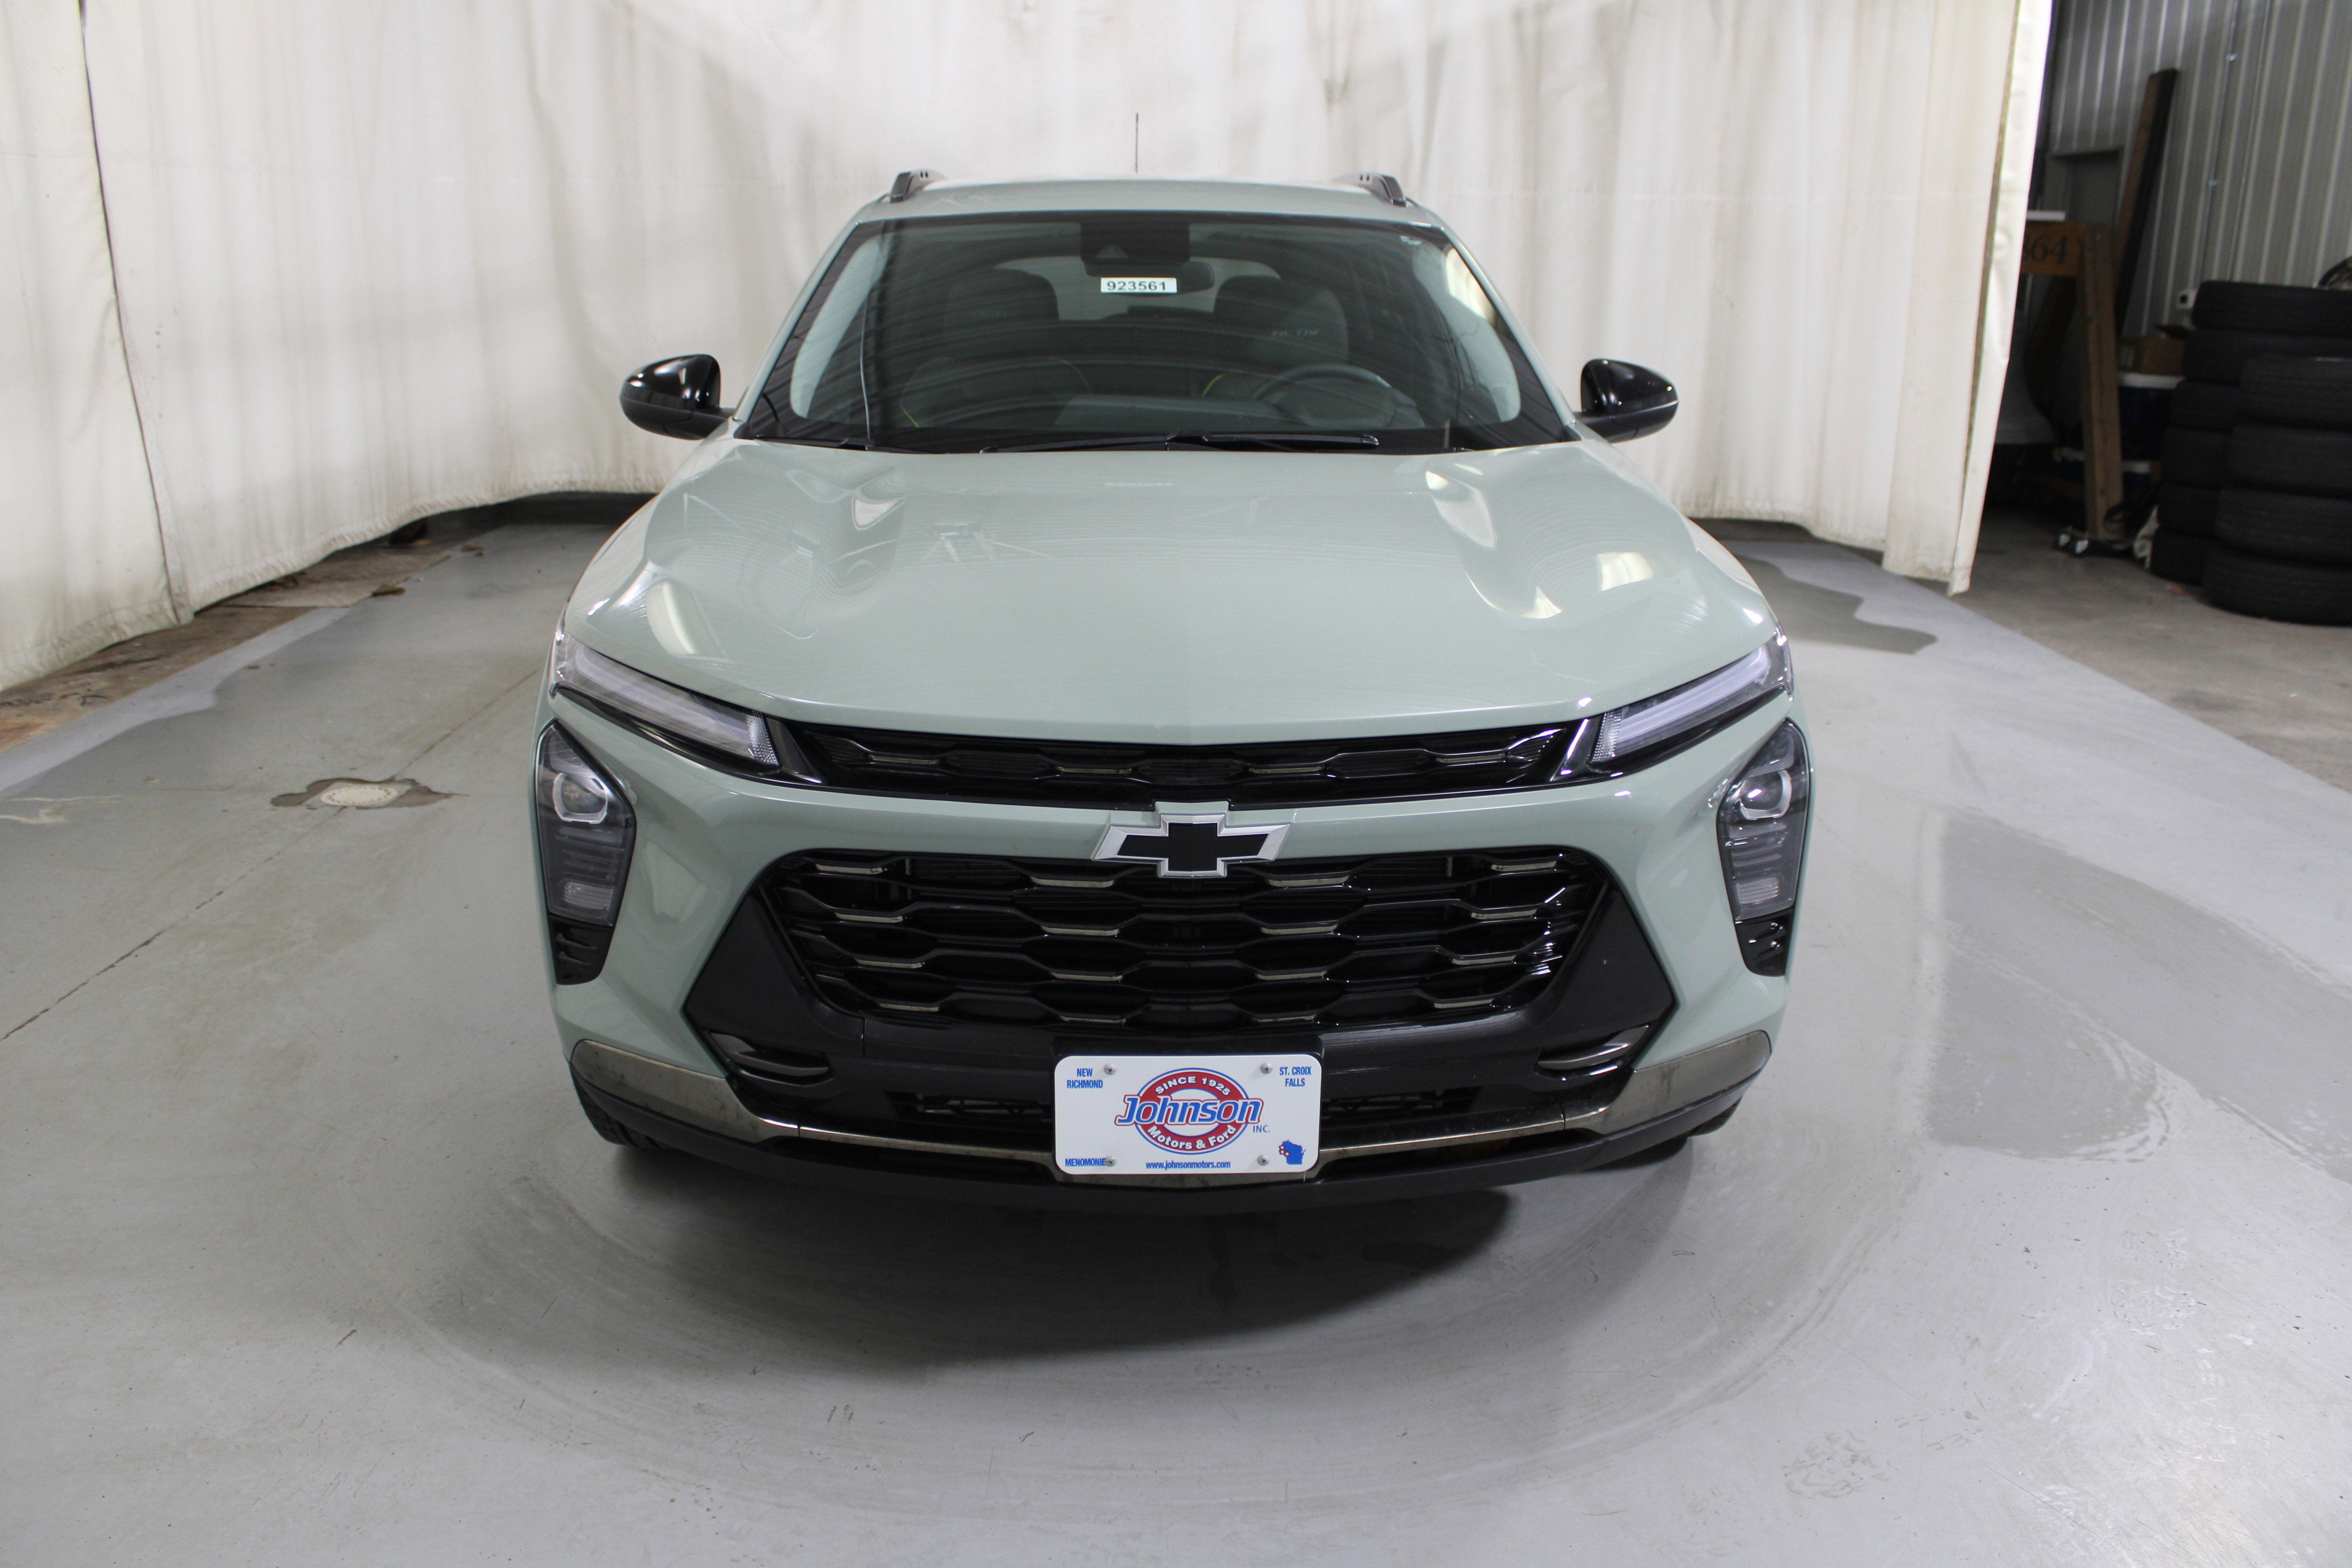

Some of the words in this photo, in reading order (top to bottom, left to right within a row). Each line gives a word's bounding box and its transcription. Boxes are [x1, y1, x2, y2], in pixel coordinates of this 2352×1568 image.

[2023, 233, 2069, 264] 64
[1107, 281, 1166, 291] 923561
[1076, 1068, 1093, 1077] NEW
[1279, 1067, 1290, 1076] ST.
[1292, 1067, 1312, 1076] CROIX
[1067, 1080, 1103, 1089] RICHMOND
[1155, 1076, 1197, 1094] SINCE
[1201, 1077, 1231, 1096] 1925
[1285, 1078, 1305, 1087] FALLS
[1116, 1096, 1262, 1125] Johnson
[1252, 1125, 1271, 1133] INC.
[1147, 1125, 1193, 1150] Motors
[1196, 1139, 1207, 1149] &
[1207, 1124, 1237, 1147] Ford
[1065, 1158, 1107, 1167] MENOMONIE
[1146, 1161, 1231, 1171] www.johnsonmotors.com
